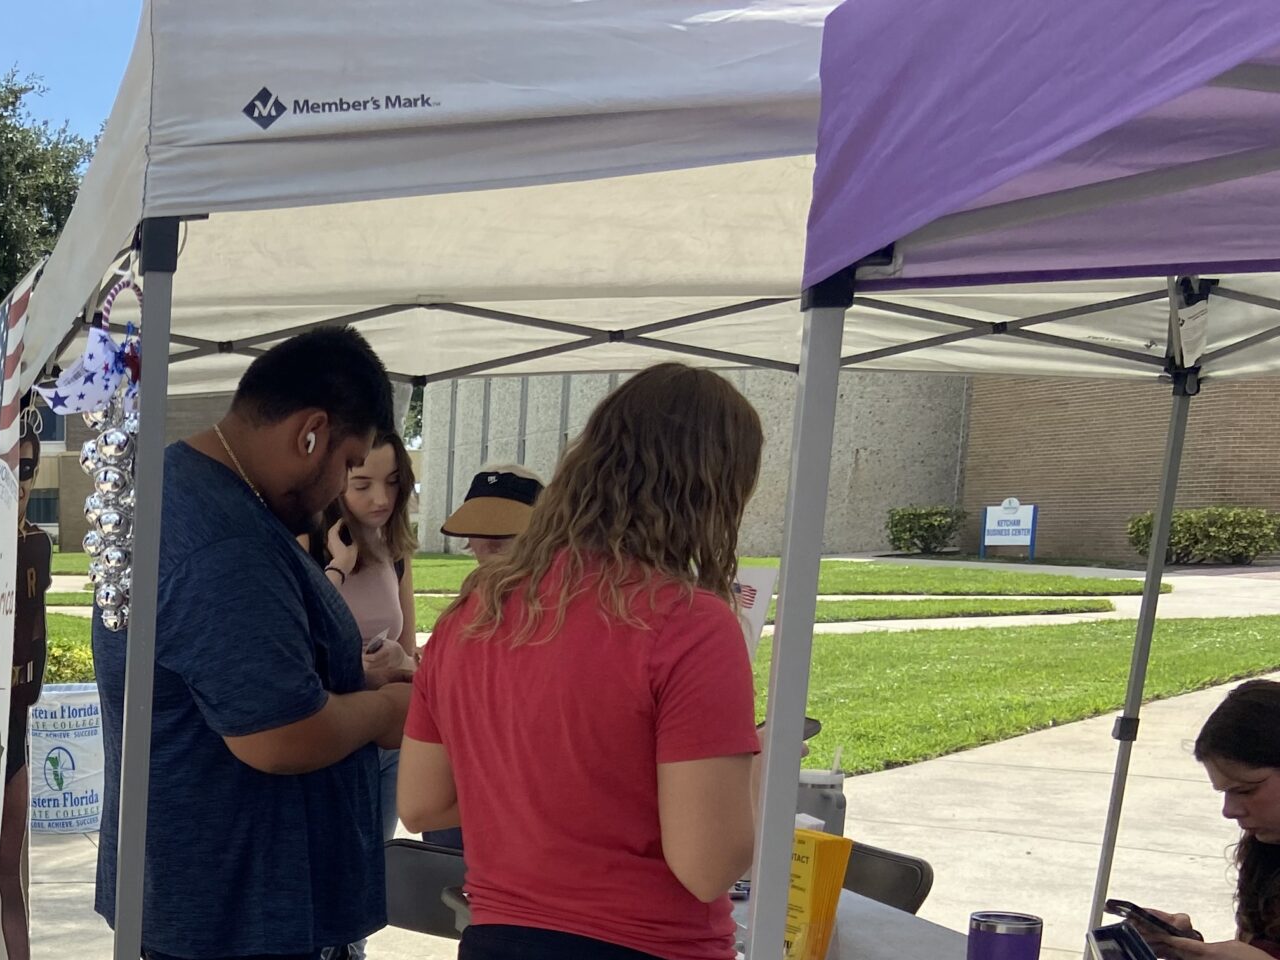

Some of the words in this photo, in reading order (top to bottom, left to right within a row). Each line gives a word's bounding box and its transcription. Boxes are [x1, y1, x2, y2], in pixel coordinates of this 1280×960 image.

[293, 96, 381, 114] Member's
[384, 94, 432, 110] Mark
[1011, 528, 1031, 536] CENTER
[62, 788, 99, 808] Florida
